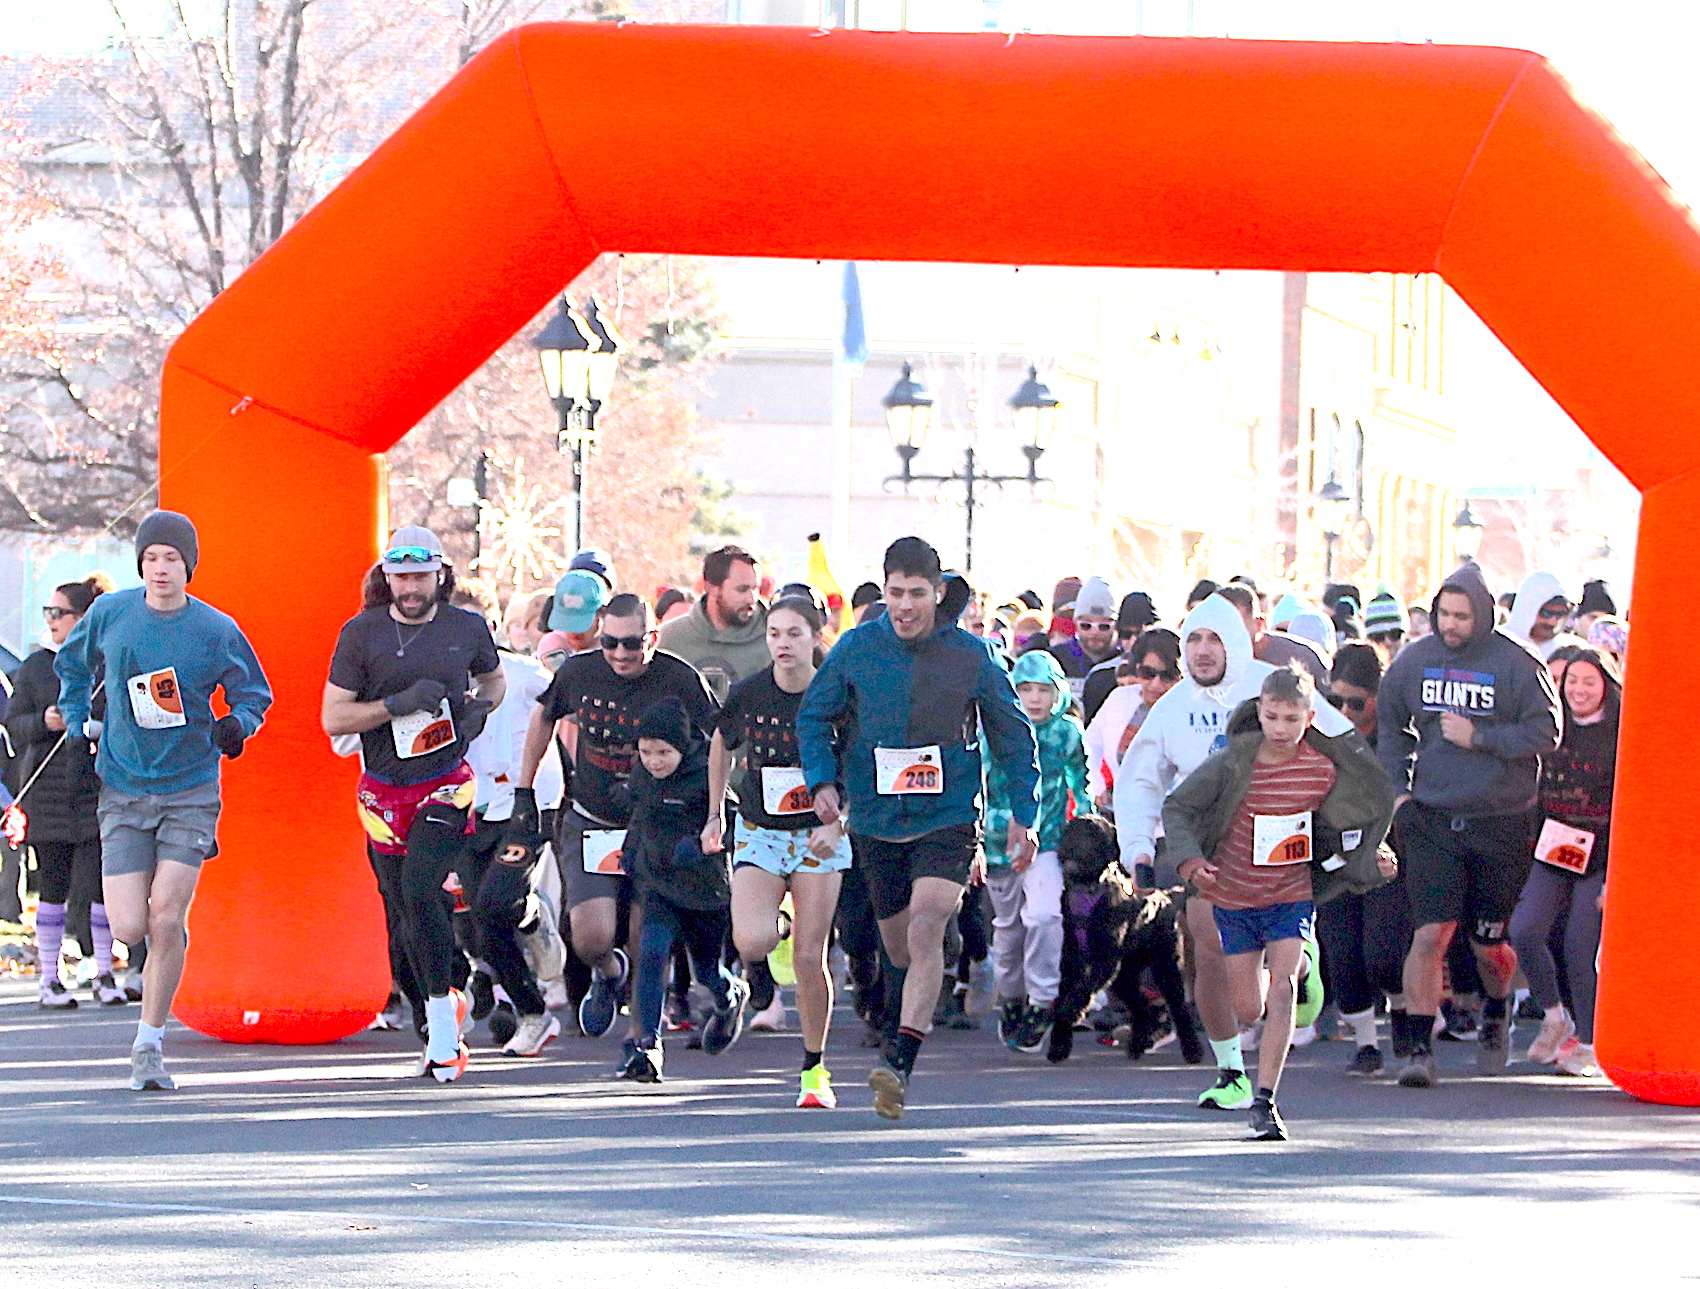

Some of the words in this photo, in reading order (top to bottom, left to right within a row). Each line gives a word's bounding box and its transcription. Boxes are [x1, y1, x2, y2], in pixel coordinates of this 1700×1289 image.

[156, 678, 174, 699] 45
[1422, 679, 1496, 710] GIANTS
[421, 724, 452, 750] 232
[905, 770, 936, 789] 248
[1284, 839, 1306, 860] 113
